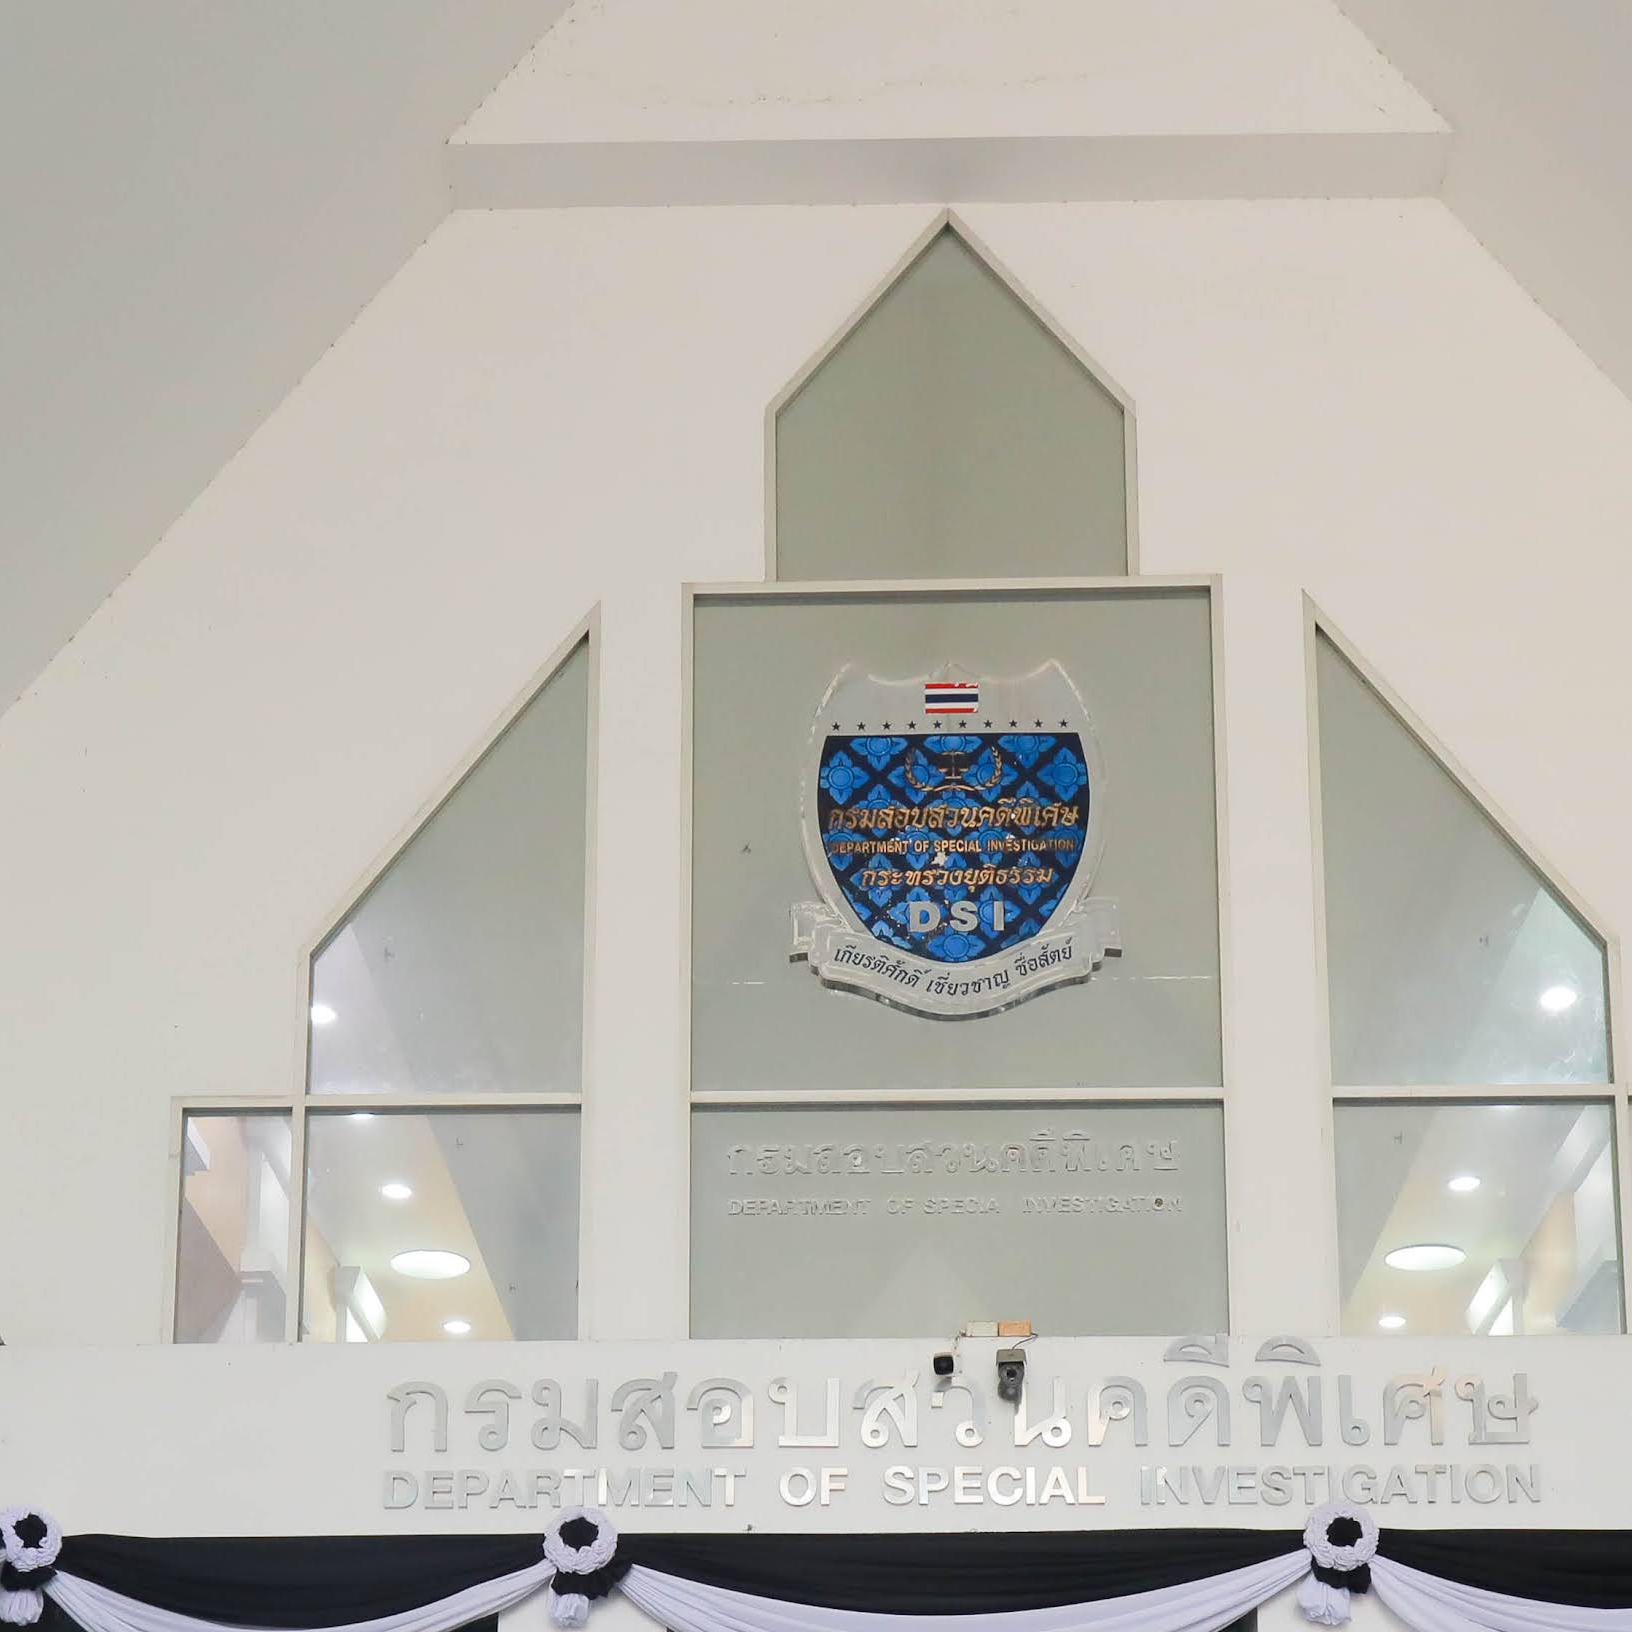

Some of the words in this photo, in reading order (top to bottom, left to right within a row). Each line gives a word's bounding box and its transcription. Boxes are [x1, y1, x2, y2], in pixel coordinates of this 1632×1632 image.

[828, 797, 1079, 829] กรมสอบสวนคดีพิเศษ
[833, 839, 910, 854] DEPARTMENT
[914, 839, 930, 853] OF
[934, 839, 982, 853] SPECIAL
[861, 863, 1053, 893] กระทรวงยุติธรรม
[909, 900, 1005, 933] DSI
[386, 1332, 1540, 1452] กรมสอบสวนคดีพิเศษ
[383, 1466, 747, 1510] DEPARTMENT
[778, 1466, 849, 1506] OF
[882, 1464, 1106, 1507] SPECIAL
[1140, 1463, 1542, 1505] INVESTIGATION
